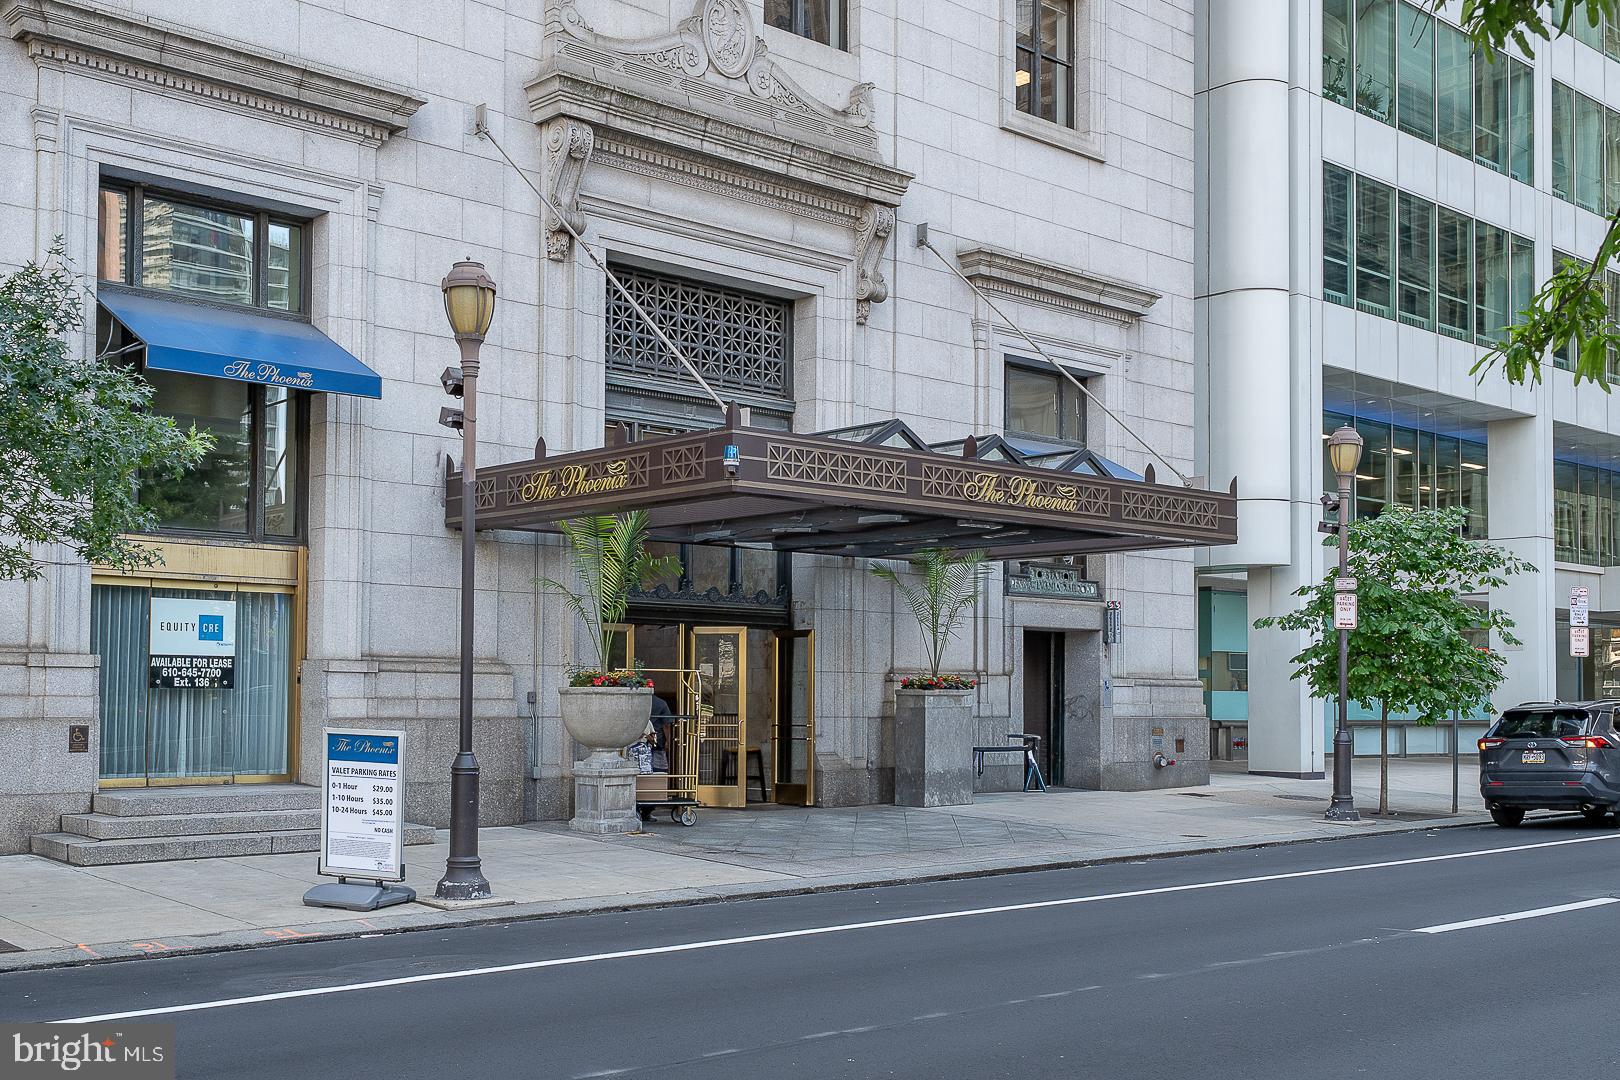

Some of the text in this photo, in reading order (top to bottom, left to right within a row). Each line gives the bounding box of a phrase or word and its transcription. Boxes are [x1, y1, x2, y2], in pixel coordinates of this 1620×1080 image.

[224, 361, 313, 387] The Phoenix
[522, 465, 627, 502] The Phoenix
[964, 473, 1078, 512] The Phoenix
[160, 622, 219, 633] EQUITY CRE
[151, 658, 232, 668] AVAILABLE FOR LEASE
[162, 668, 222, 677] 610-645-7700
[174, 678, 210, 687] Ext. 136
[333, 738, 395, 754] The Phoenix
[332, 767, 397, 778] VALET PARKING RATES
[372, 785, 393, 793] $29.00
[346, 795, 364, 803] Hours
[332, 806, 349, 814] 10-24
[349, 807, 367, 815] Hours
